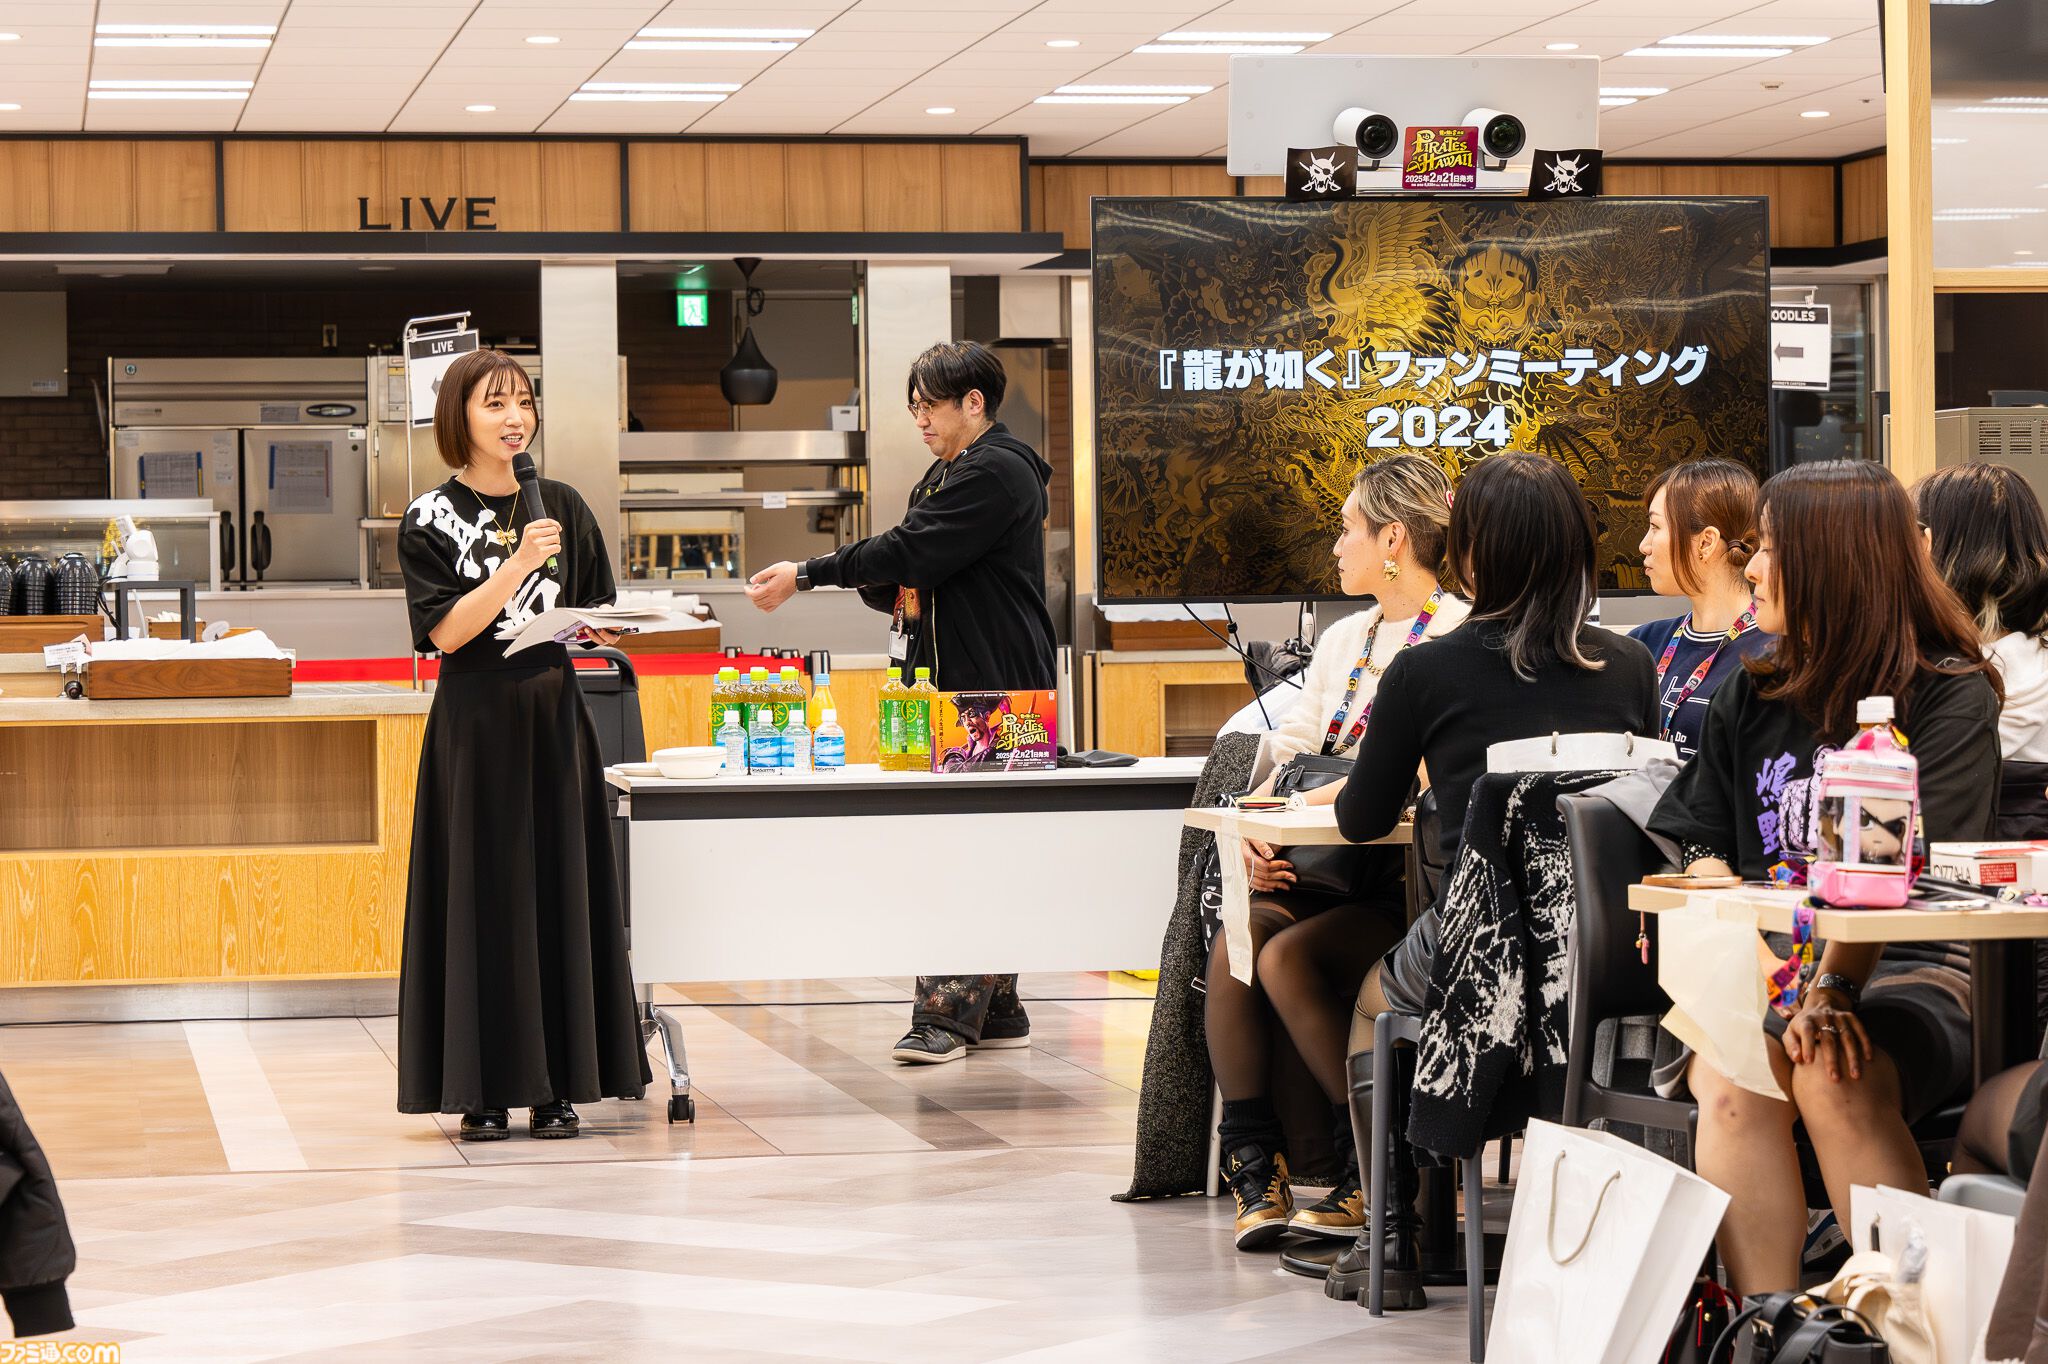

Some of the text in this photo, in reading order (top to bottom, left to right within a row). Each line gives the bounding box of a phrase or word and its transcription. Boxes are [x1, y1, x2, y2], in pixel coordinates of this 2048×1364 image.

[358, 197, 497, 230] LIVE
[1770, 309, 1817, 322] OODLES
[431, 340, 454, 354] LIVE
[1159, 346, 1710, 391] 『龍が如く』ファンミーティング
[1366, 405, 1512, 448] 2024
